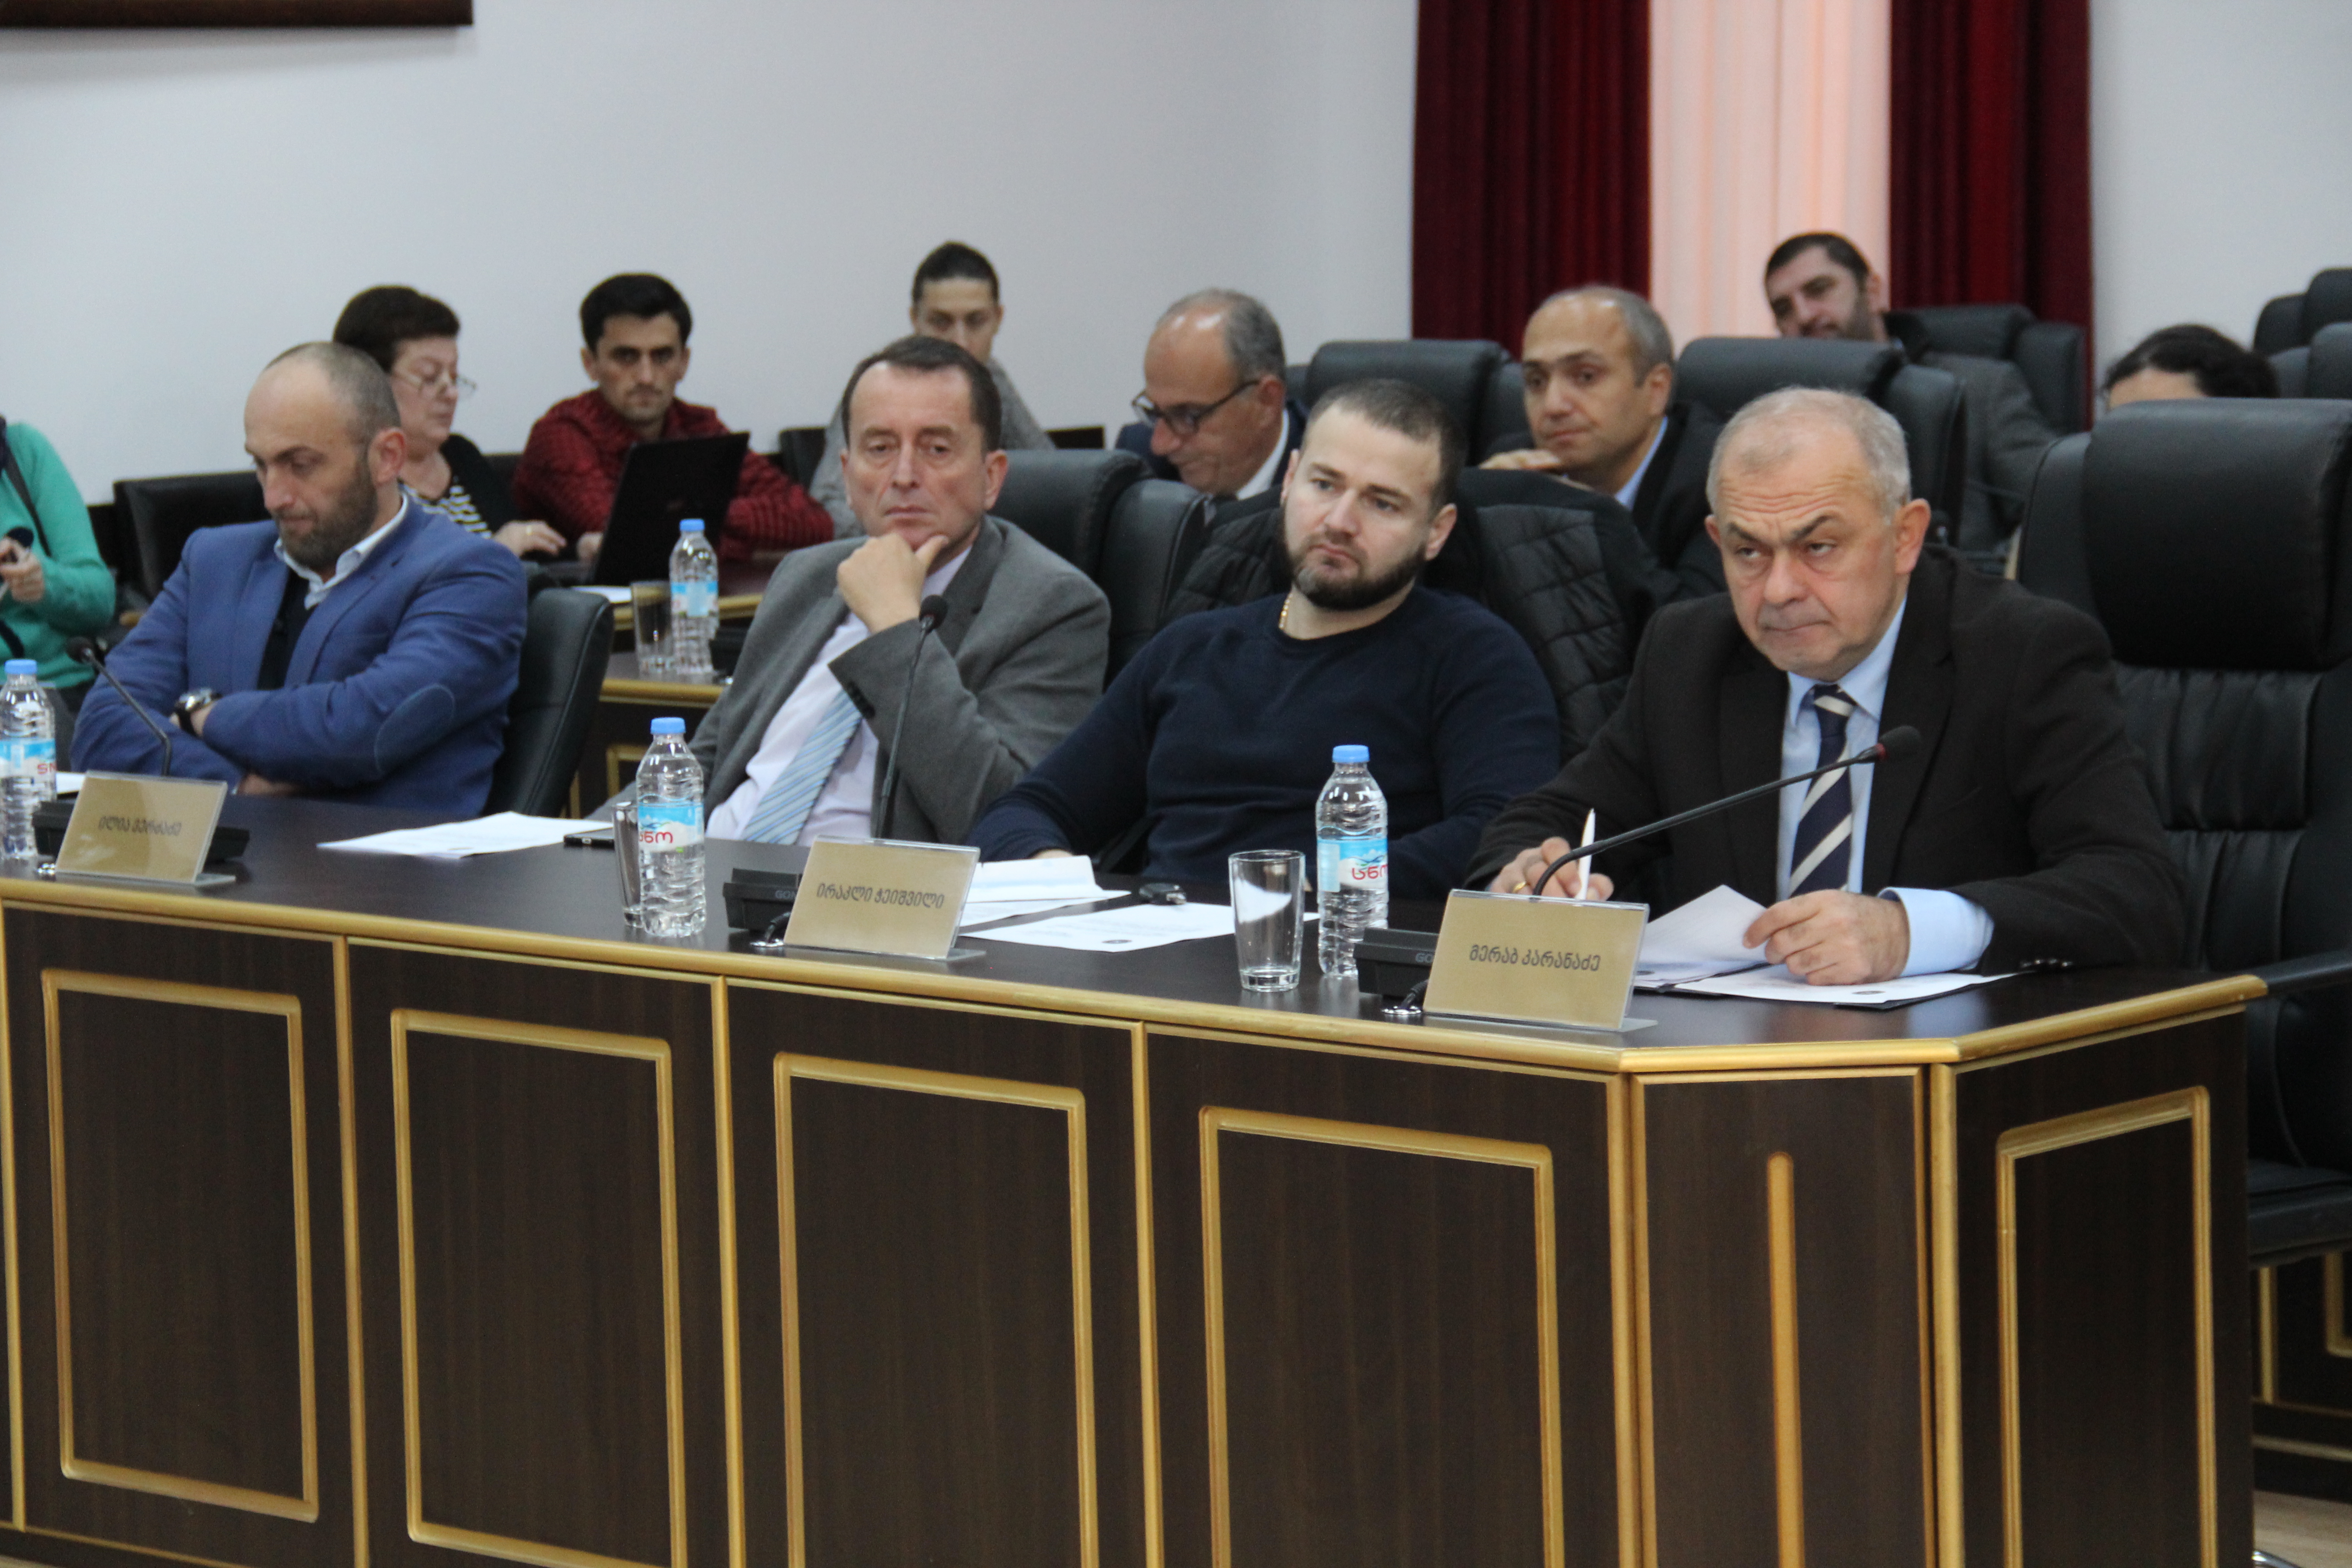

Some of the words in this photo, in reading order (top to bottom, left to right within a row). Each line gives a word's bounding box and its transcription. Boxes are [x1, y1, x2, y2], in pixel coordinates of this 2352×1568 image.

[816, 882, 873, 902] ირაკლი
[1415, 952, 1434, 963] GO
[1469, 944, 1519, 965] მერაბ
[1521, 949, 1601, 972] კარანაძე
